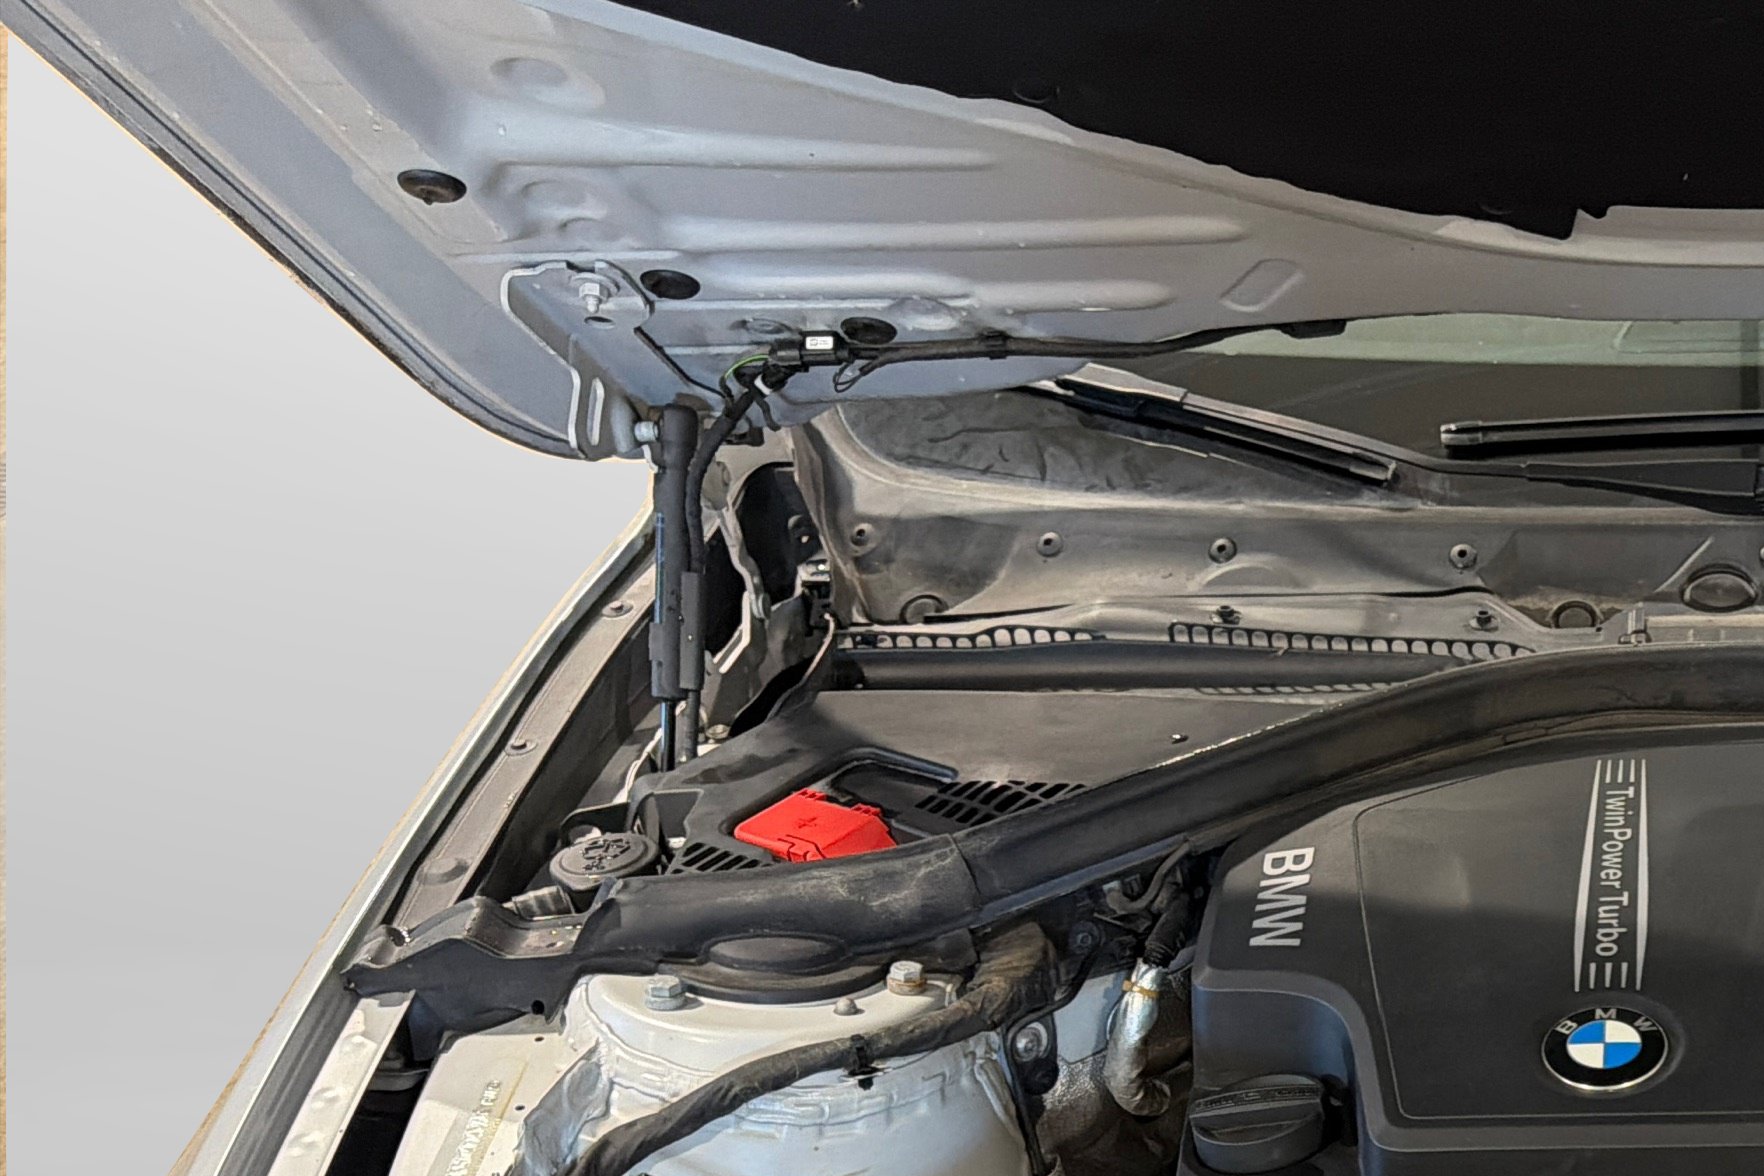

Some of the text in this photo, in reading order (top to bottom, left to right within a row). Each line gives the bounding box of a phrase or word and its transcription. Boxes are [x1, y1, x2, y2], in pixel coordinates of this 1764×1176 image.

[1249, 847, 1315, 947] BMW
[1595, 786, 1635, 957] TwinPower Turbo
[1554, 1008, 1657, 1035] BMW
